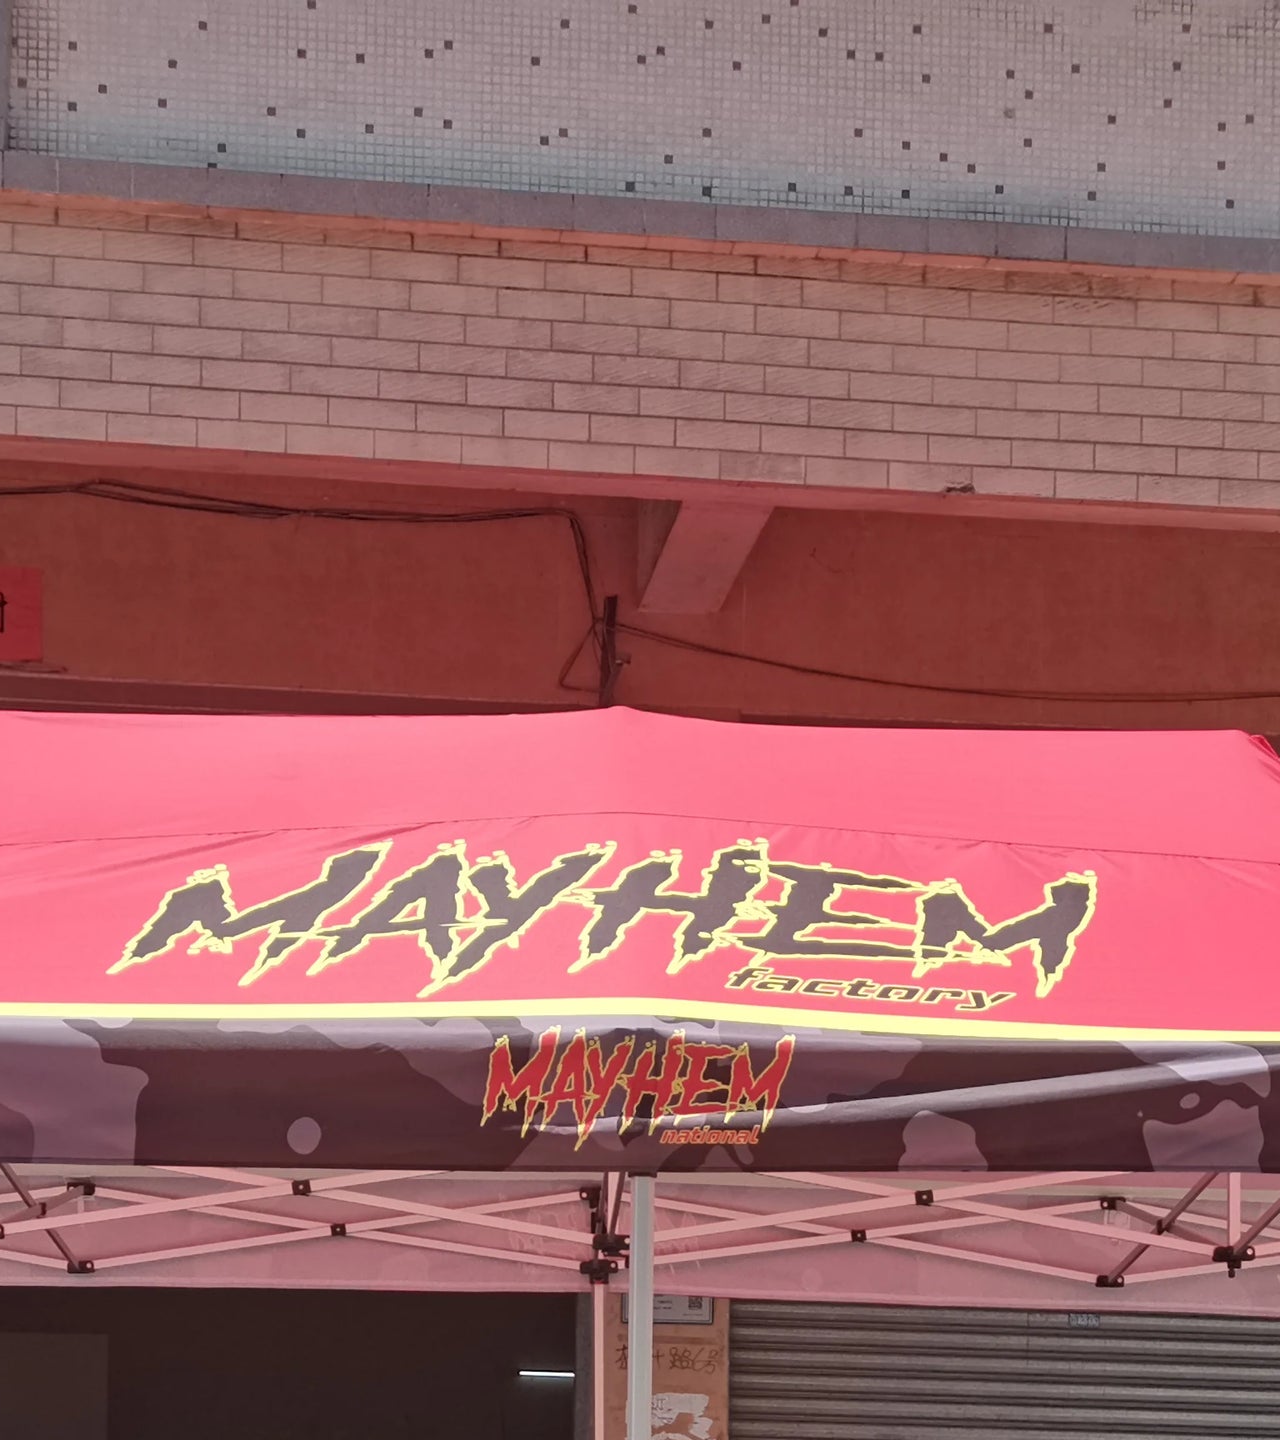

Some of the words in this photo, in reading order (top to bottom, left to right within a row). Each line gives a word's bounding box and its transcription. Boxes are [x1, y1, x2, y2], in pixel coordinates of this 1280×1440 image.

[106, 836, 1100, 998] MAYHEM
[724, 966, 1017, 1011] factory
[480, 1024, 798, 1151] MAYHEM
[659, 1124, 761, 1145] national
